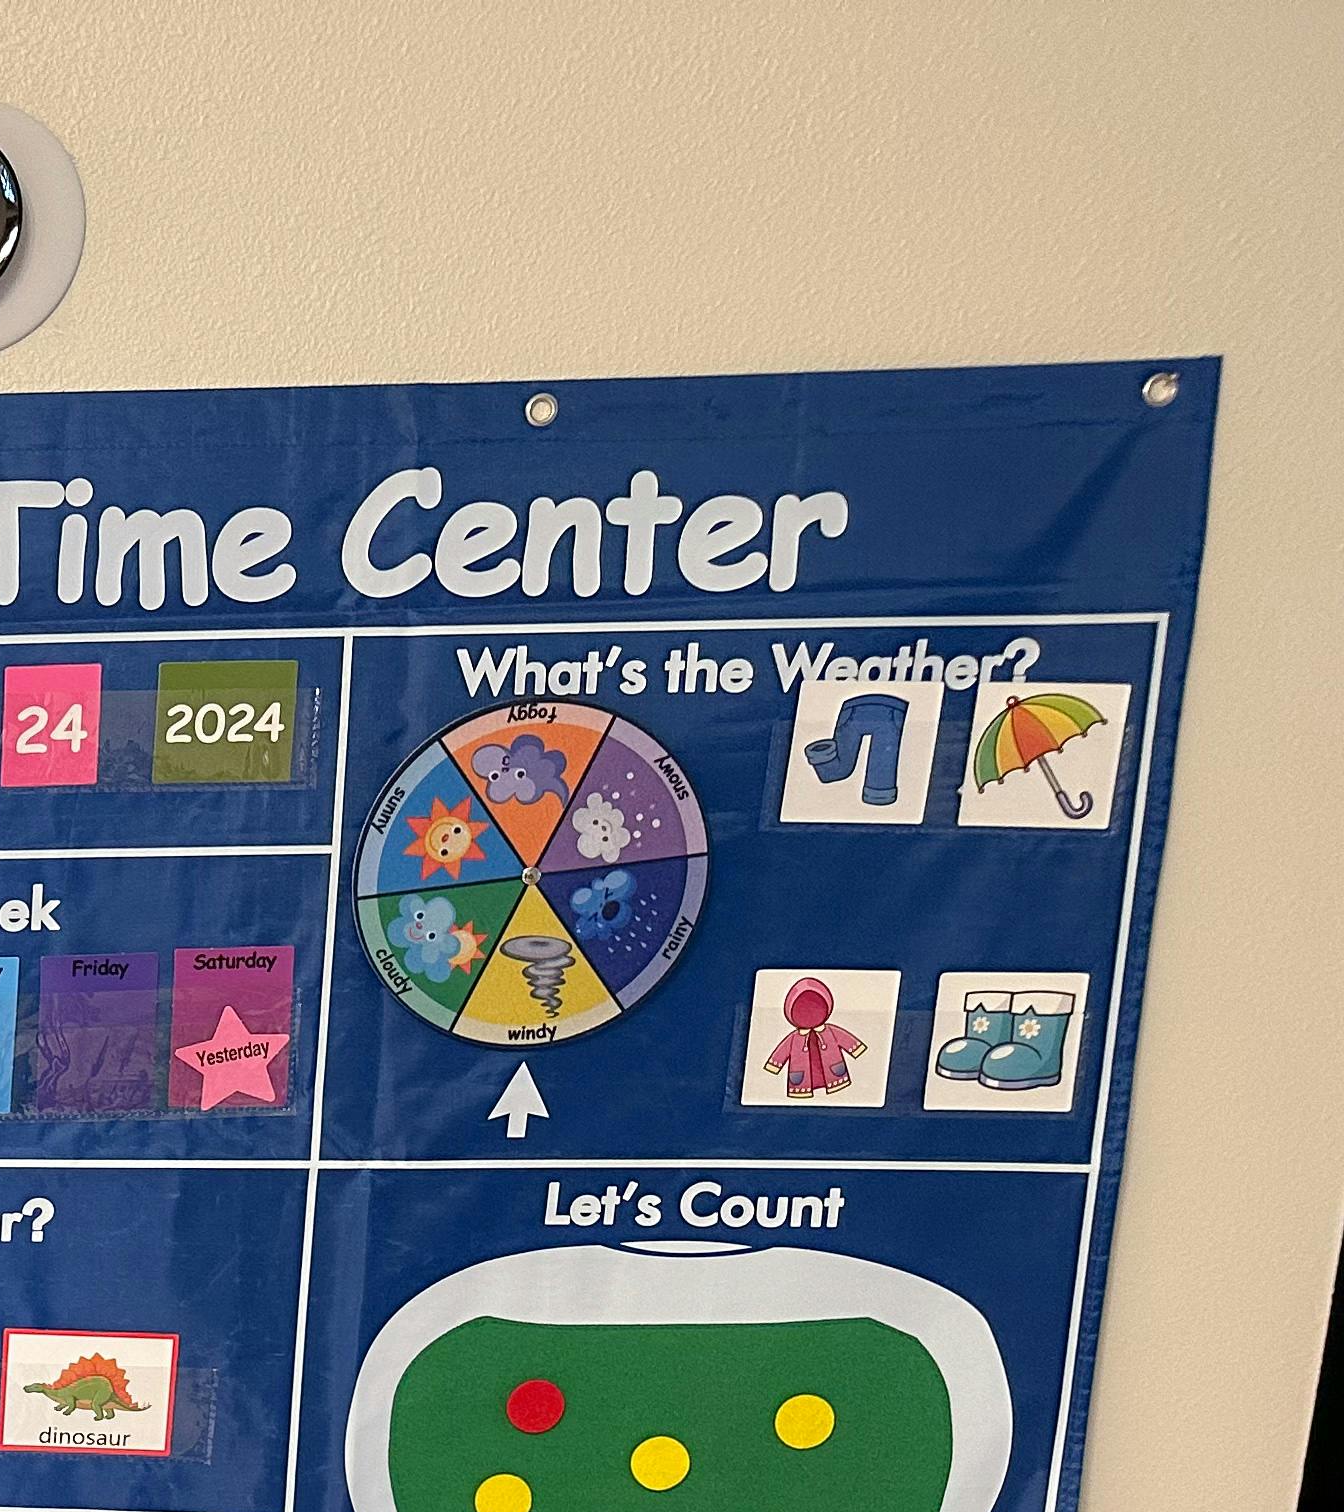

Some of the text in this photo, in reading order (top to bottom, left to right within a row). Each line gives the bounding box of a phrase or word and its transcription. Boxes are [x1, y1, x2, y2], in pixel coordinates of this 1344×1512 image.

[342, 466, 849, 598] Center
[457, 646, 646, 697] What's
[664, 642, 753, 694] the
[15, 707, 87, 755] 24
[165, 704, 285, 744] 2024
[507, 706, 557, 723] foggy
[654, 755, 689, 801] snowy
[372, 786, 406, 835] sunny
[662, 916, 693, 960] rainy
[71, 960, 129, 980] Friday
[193, 954, 277, 972] Saturday
[376, 948, 412, 996] cloudy
[196, 1041, 270, 1067] Yesterday
[507, 1025, 557, 1043] windy
[543, 1182, 845, 1230] Let's Count
[38, 1427, 130, 1447] dinosaur
